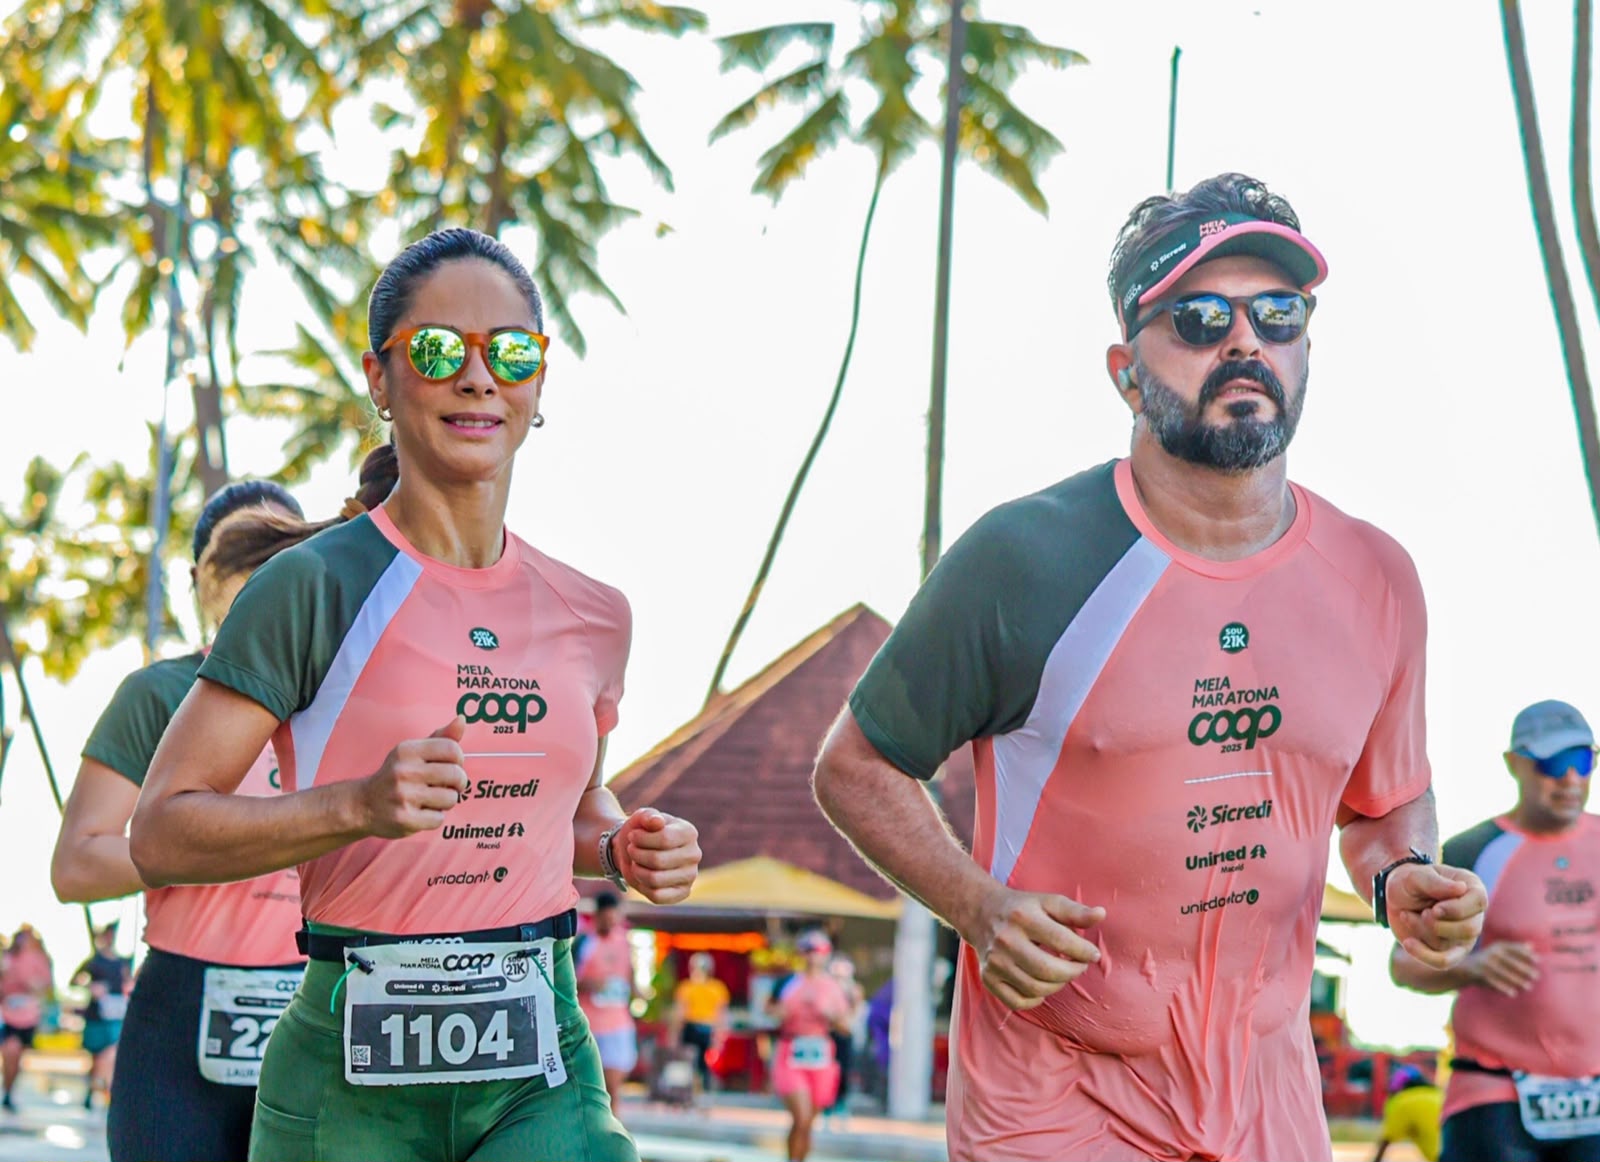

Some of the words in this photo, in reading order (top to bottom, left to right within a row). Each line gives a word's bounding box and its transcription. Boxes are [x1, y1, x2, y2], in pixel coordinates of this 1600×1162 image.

[1200, 219, 1227, 230] MEIA
[1159, 242, 1187, 264] Sicredi
[1225, 628, 1243, 636] SOU
[473, 635, 497, 647] 21K
[1222, 634, 1246, 649] 21K
[457, 664, 494, 676] MEIA
[457, 676, 541, 690] MARATONA
[1194, 675, 1231, 693] MEIA
[1192, 686, 1280, 709] MARATONA
[493, 725, 514, 734] 2025
[1220, 743, 1242, 753] 2025
[474, 779, 540, 799] Sicredi
[1210, 799, 1273, 826] Sicredi
[442, 823, 505, 840] Unimed
[1185, 845, 1247, 871] Unimed
[505, 962, 526, 976] 21K
[441, 984, 466, 992] Sicredi
[381, 1010, 515, 1066] 1104
[545, 1052, 558, 1073] 1104
